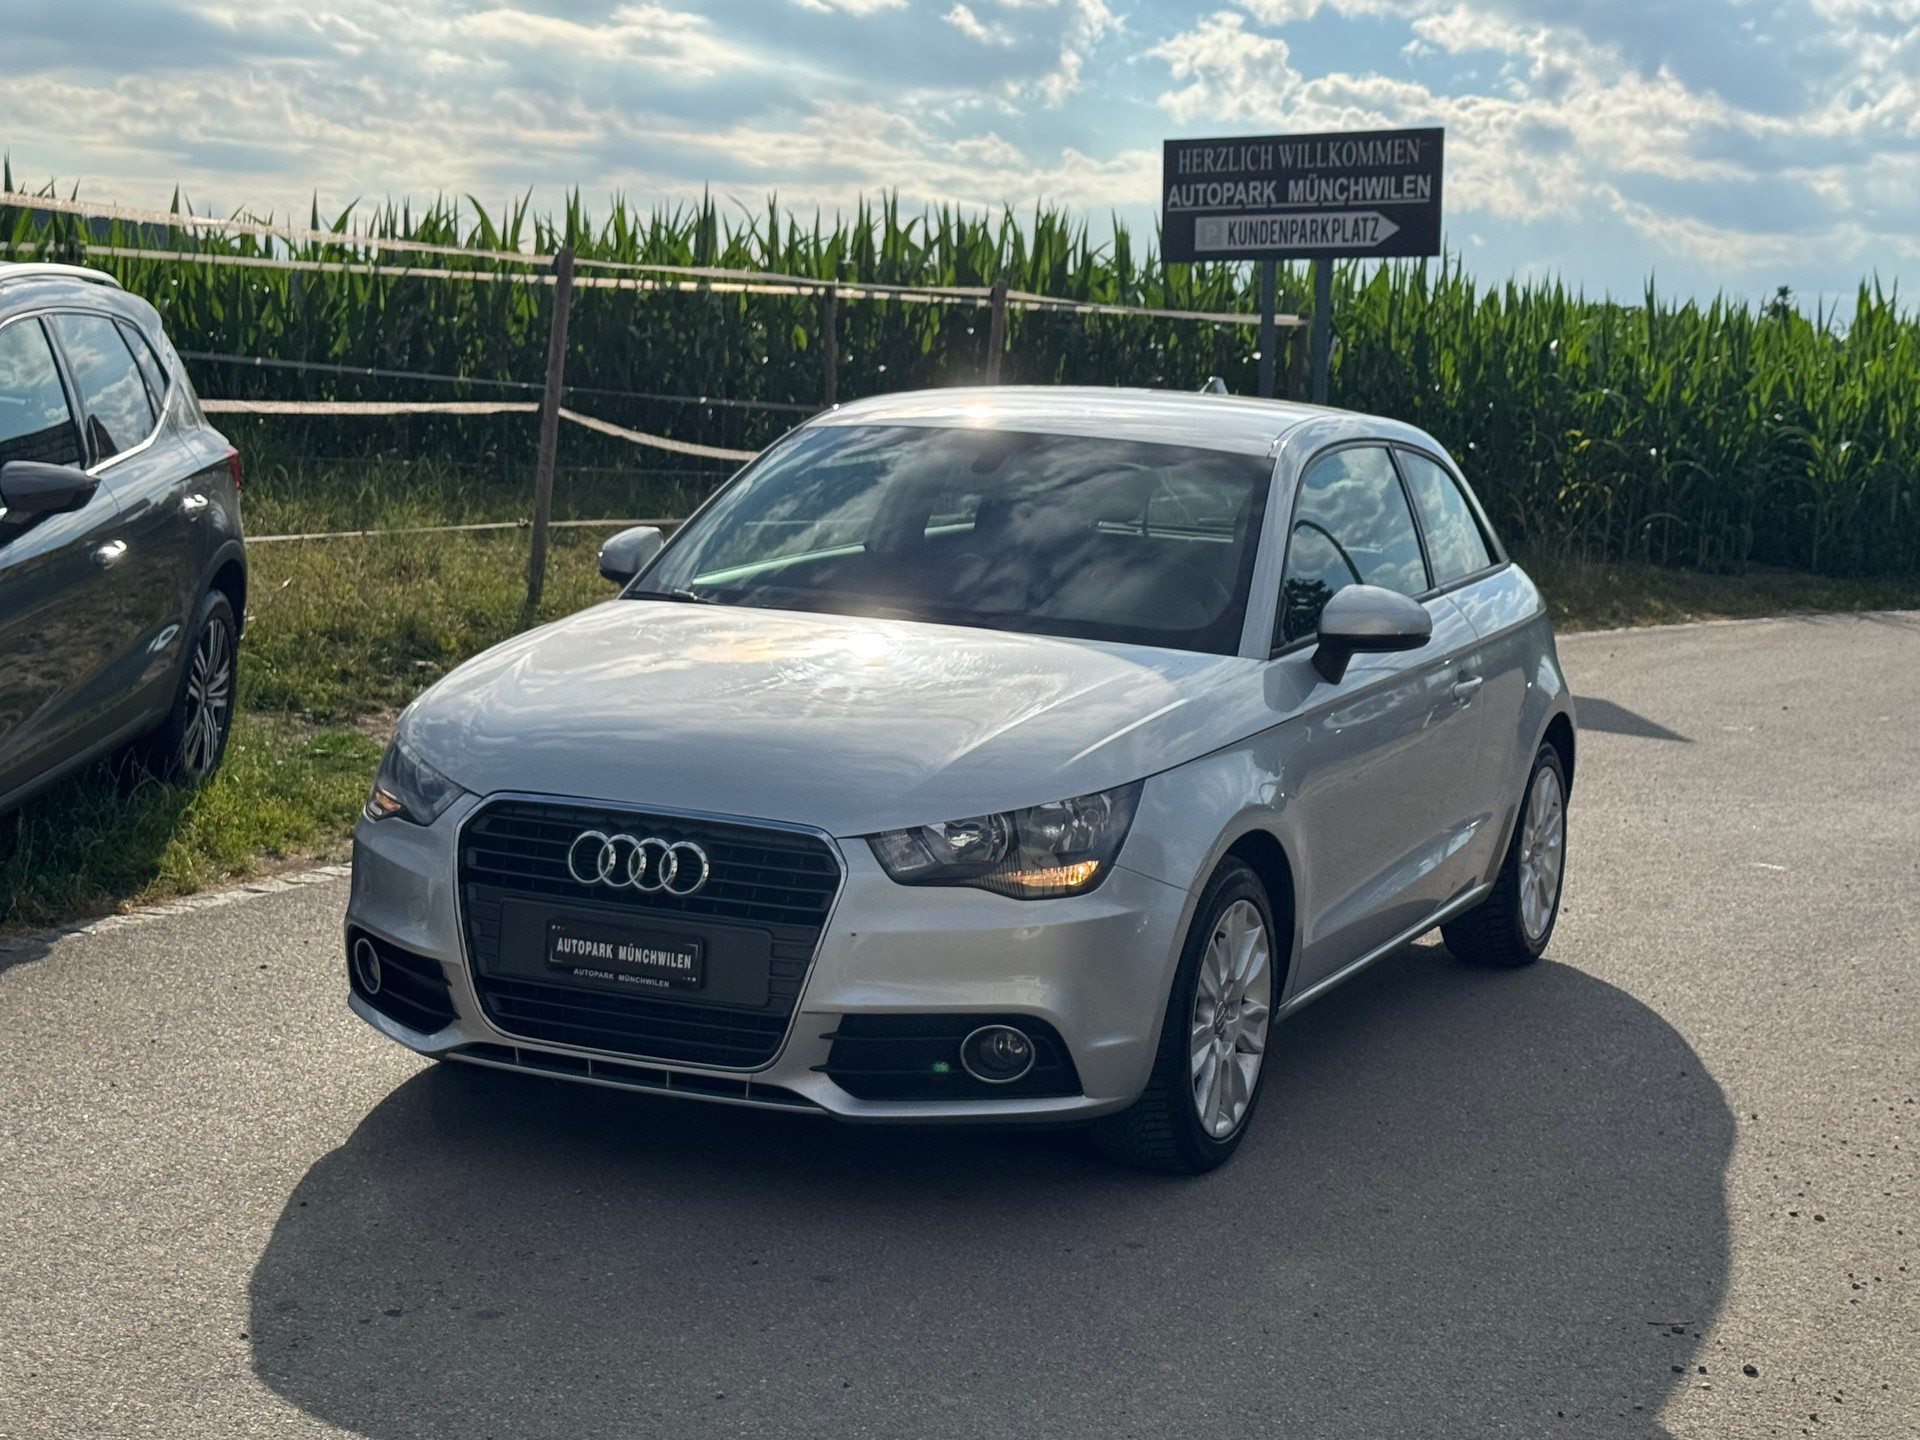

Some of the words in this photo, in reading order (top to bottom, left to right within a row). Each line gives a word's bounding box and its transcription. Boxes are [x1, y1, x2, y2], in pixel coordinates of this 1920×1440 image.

[1178, 144, 1273, 174] HERZLICH
[1278, 138, 1421, 168] WILLKOMMEN
[1168, 179, 1277, 207] AUTOPARK
[1288, 173, 1432, 203] MÜNCHWILEN
[1227, 216, 1380, 246] KUNDENPARKPLATZ
[557, 937, 613, 959] AUTOPARK
[618, 943, 692, 969] MÜNCHWILEN
[573, 968, 614, 980] AUTOPARK
[618, 974, 670, 988] MÜNCHWILEN
